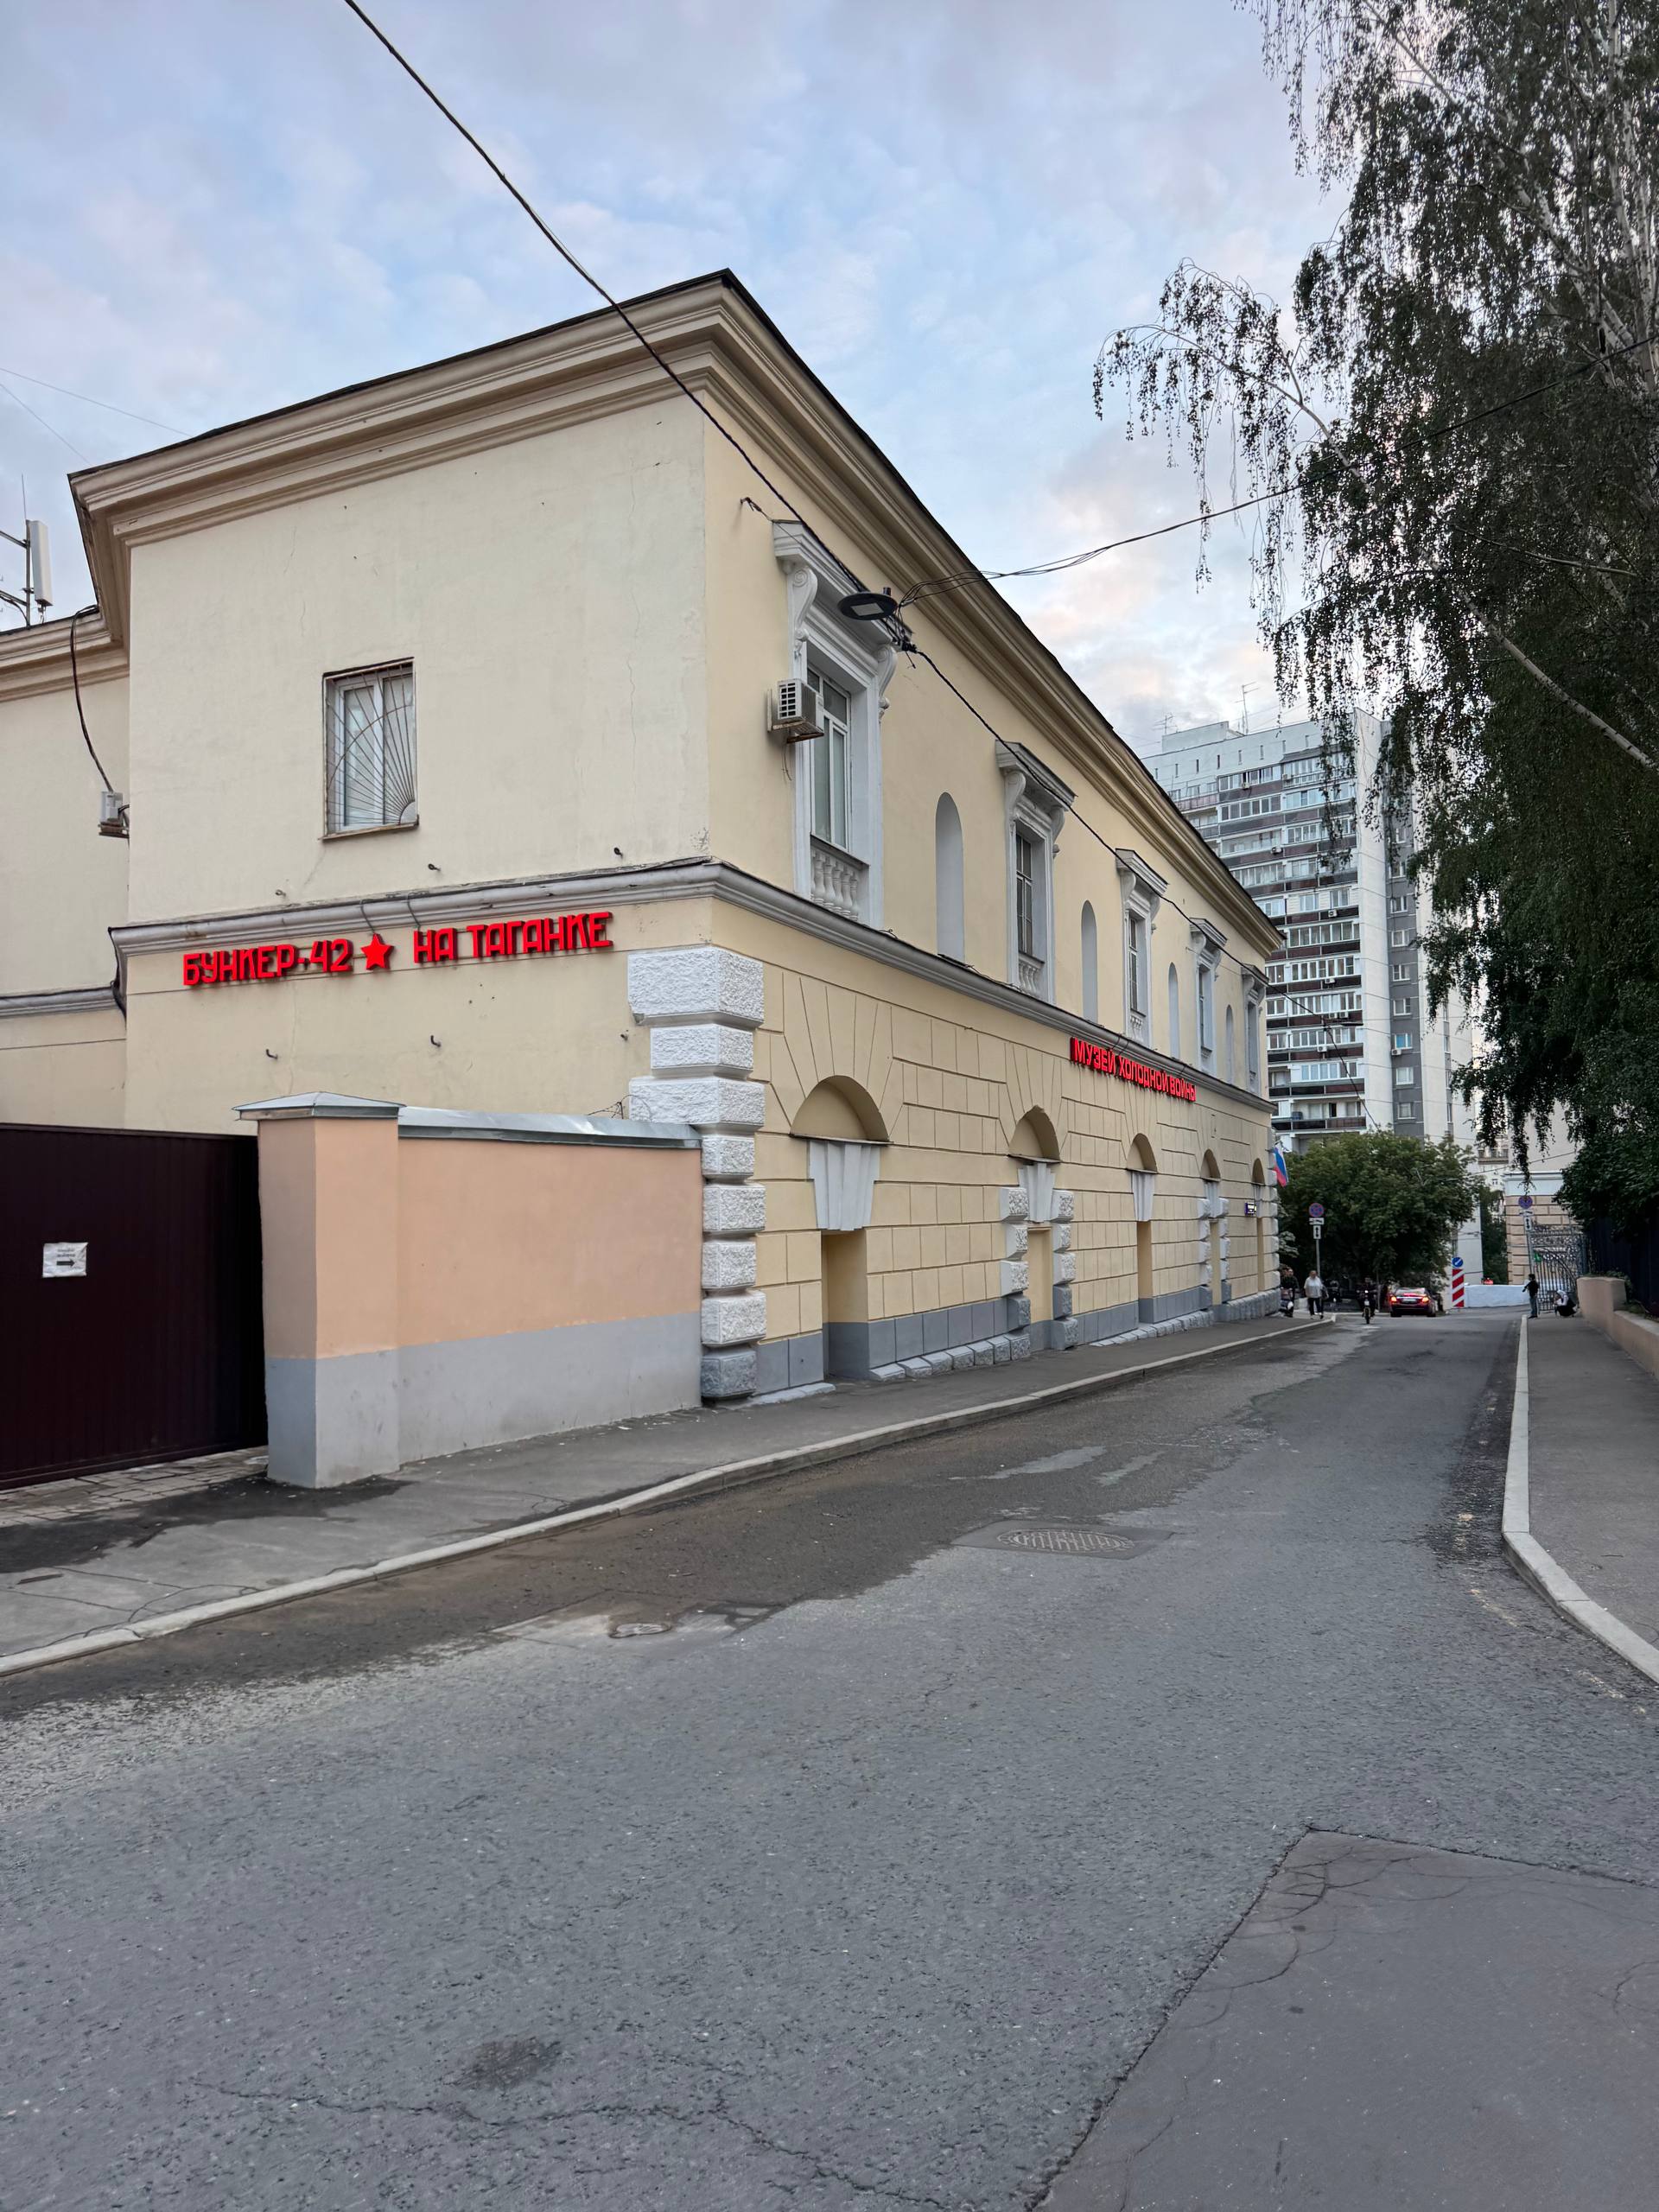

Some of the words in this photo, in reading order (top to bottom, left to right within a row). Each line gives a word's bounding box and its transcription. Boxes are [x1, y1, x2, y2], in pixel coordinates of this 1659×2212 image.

[182, 937, 353, 987] БУНКЕР-42
[413, 927, 457, 963] НА
[466, 912, 614, 958] ТАГАНКЕ
[1070, 1037, 1116, 1076] МУЗЕЙ
[1117, 1055, 1169, 1093] ХОЛОДНОЙ
[1169, 1075, 1197, 1102] ВОЙНЫ
